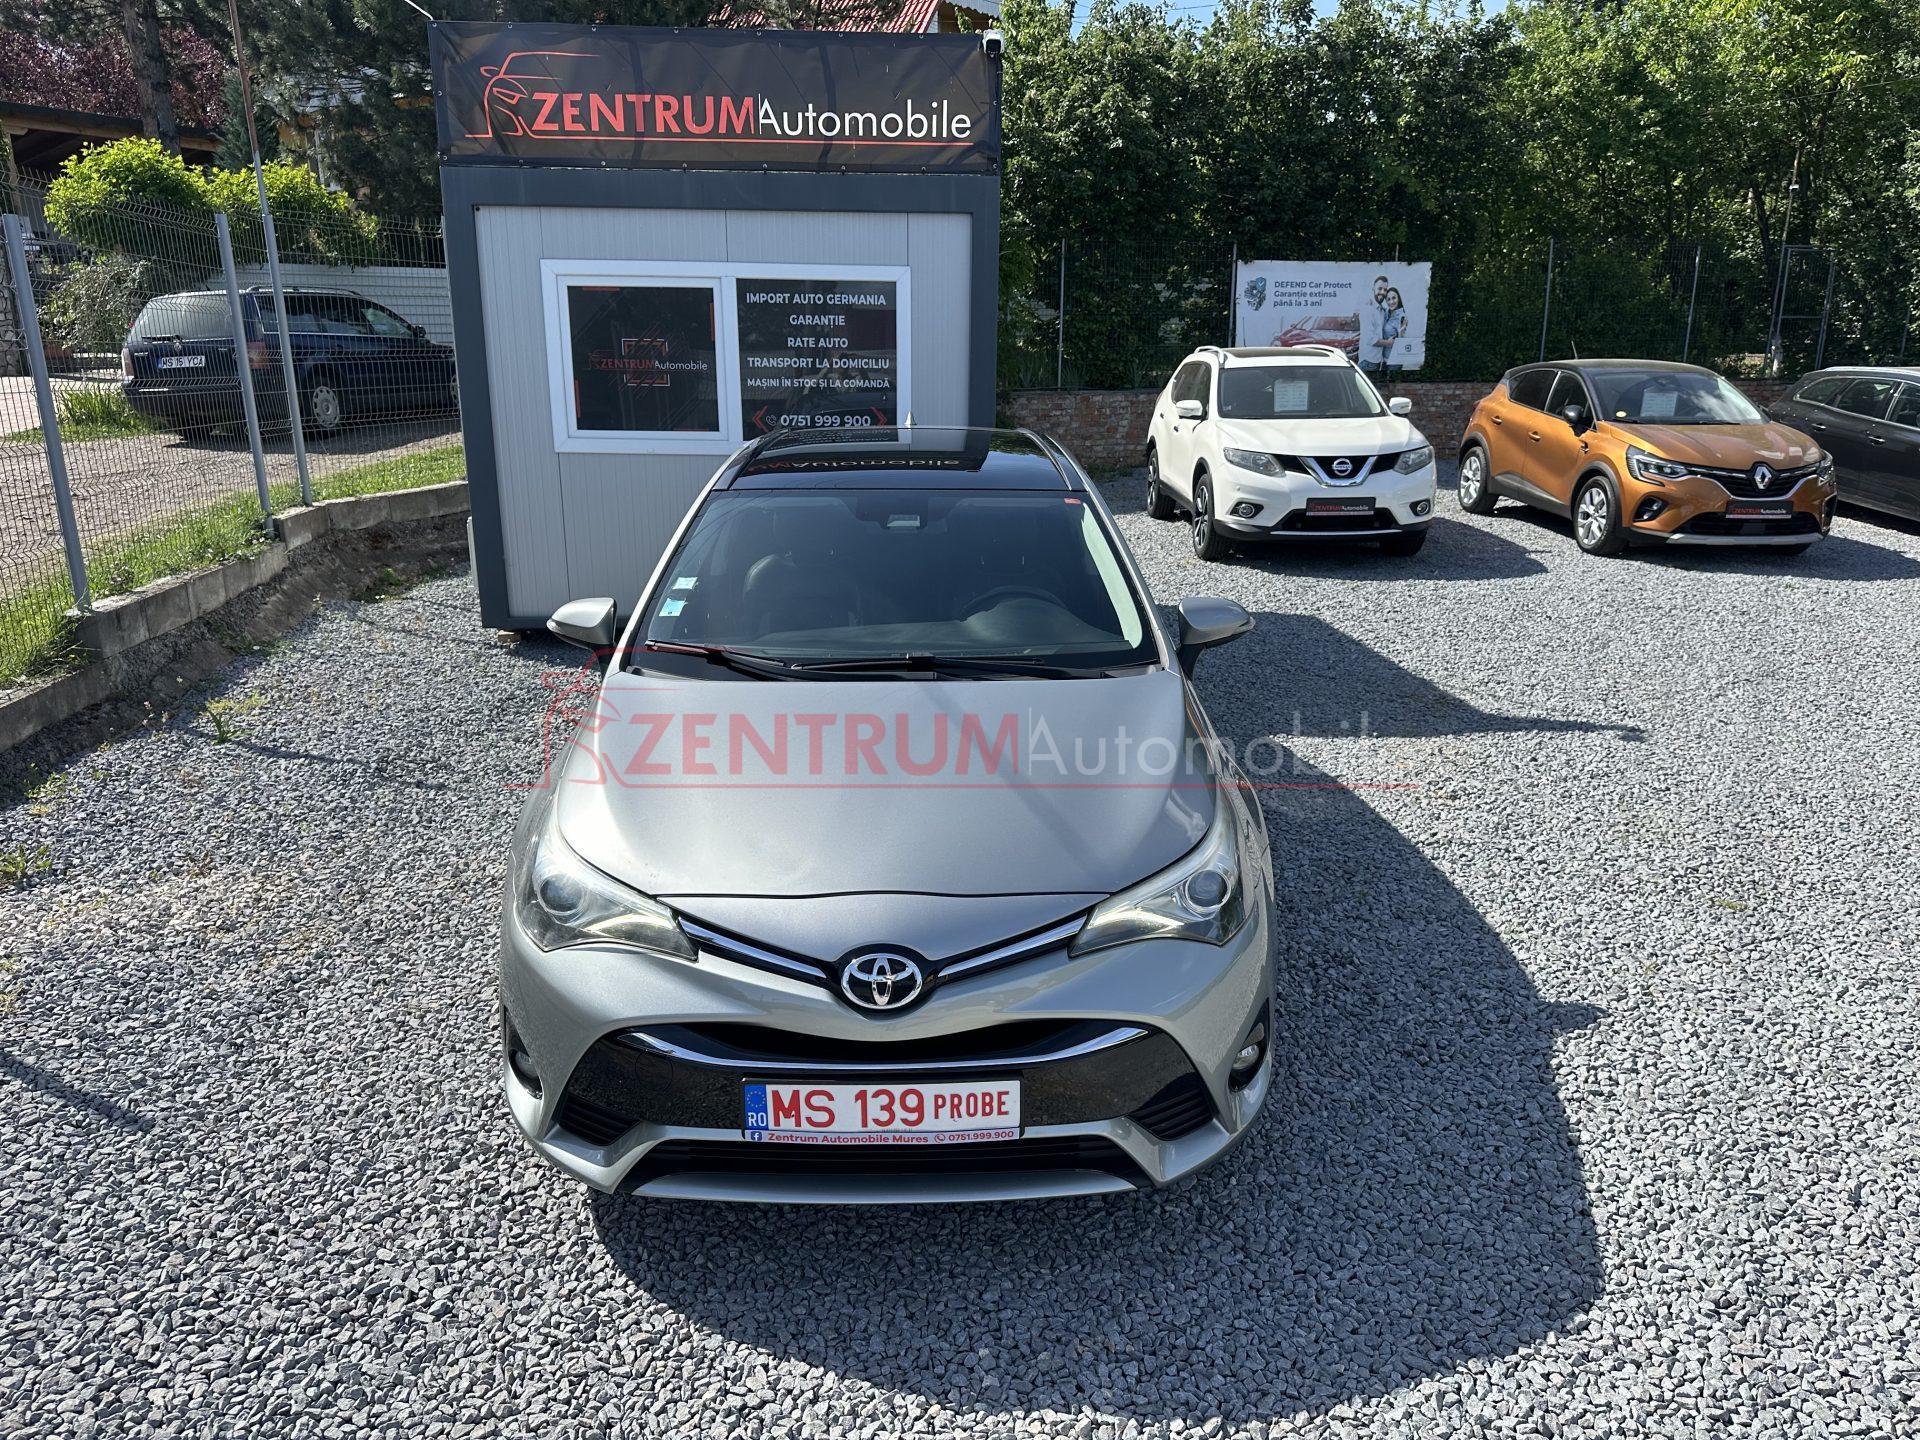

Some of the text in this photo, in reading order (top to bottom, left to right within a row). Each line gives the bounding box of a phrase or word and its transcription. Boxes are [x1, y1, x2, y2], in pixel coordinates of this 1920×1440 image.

[531, 91, 971, 138] ZENTRUM Automobile
[1274, 281, 1352, 289] DEFEND Car Protect
[746, 293, 886, 305] IMPORT AUTO GERMANIA
[1274, 290, 1337, 299] Garanție extinsă
[1273, 300, 1293, 308] până
[790, 314, 846, 328] GARANȚIE
[787, 337, 849, 348] RATE AUTO
[601, 359, 708, 371] ZENTRUM Automobile
[747, 357, 889, 369] TRANSPORT LA DOMICILIU
[747, 378, 780, 390] MAȘINI
[781, 376, 792, 388] ÎN
[794, 379, 817, 388] STOC
[829, 379, 841, 388] LA
[843, 377, 890, 388] COMANDĂ
[780, 414, 872, 427] 0751 999 900
[771, 1088, 1011, 1128] MS 139 PROBE
[748, 1112, 767, 1127] RO
[768, 1132, 818, 1143] Zentrum
[821, 1133, 890, 1144] Automobile
[892, 1134, 929, 1144] Mures
[948, 1129, 1015, 1142] 0751.999.900
